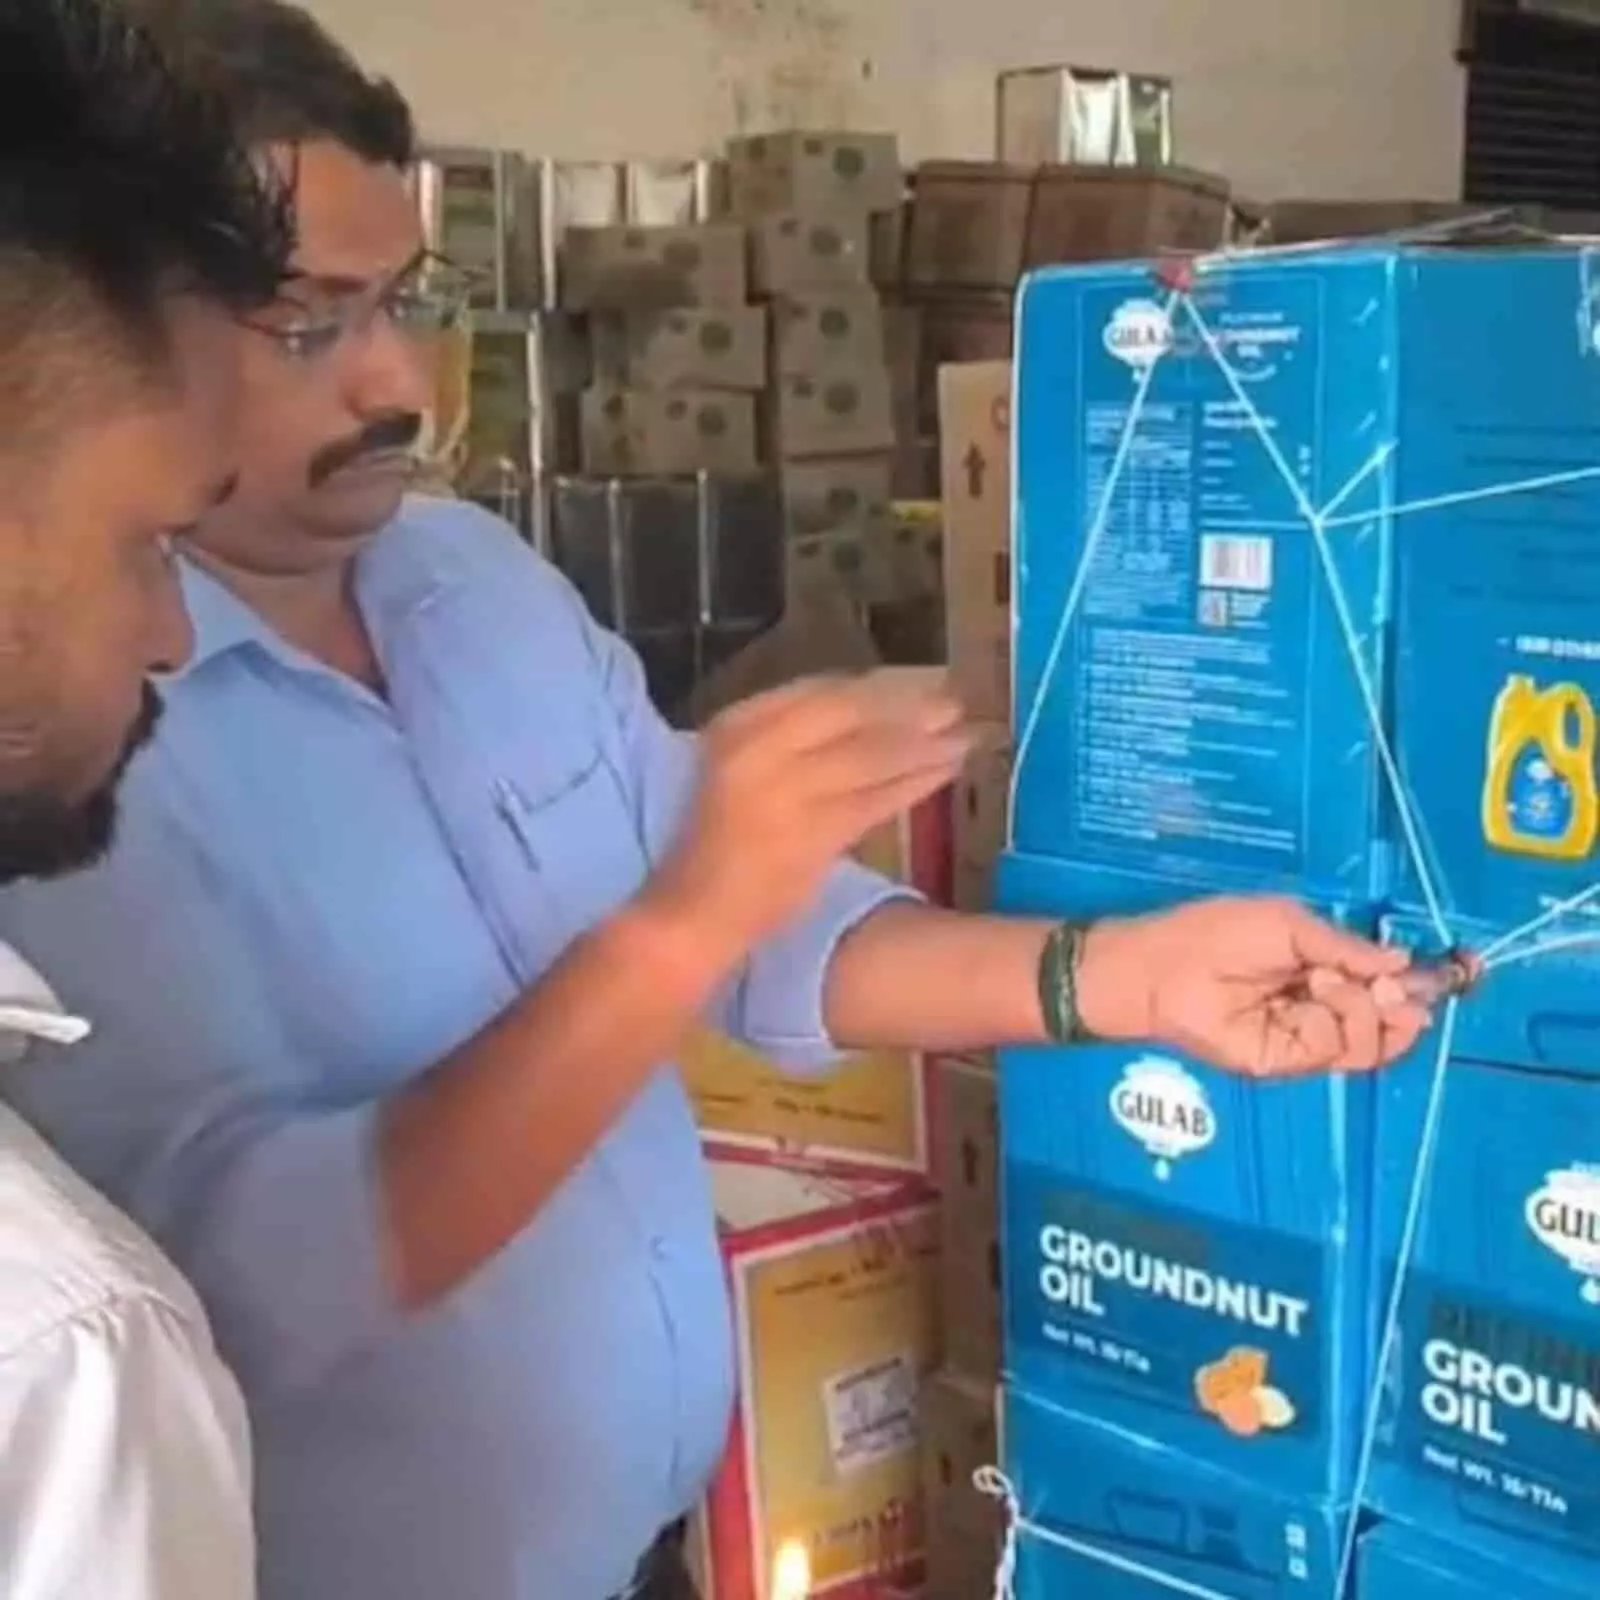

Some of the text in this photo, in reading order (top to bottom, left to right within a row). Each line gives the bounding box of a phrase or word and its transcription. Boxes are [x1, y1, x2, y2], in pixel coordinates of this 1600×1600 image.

[1117, 1089, 1209, 1137] GULAB
[1039, 1265, 1106, 1317] OIL
[1040, 1223, 1309, 1339] GROUNDNUT
[1421, 1381, 1508, 1446] OIL
